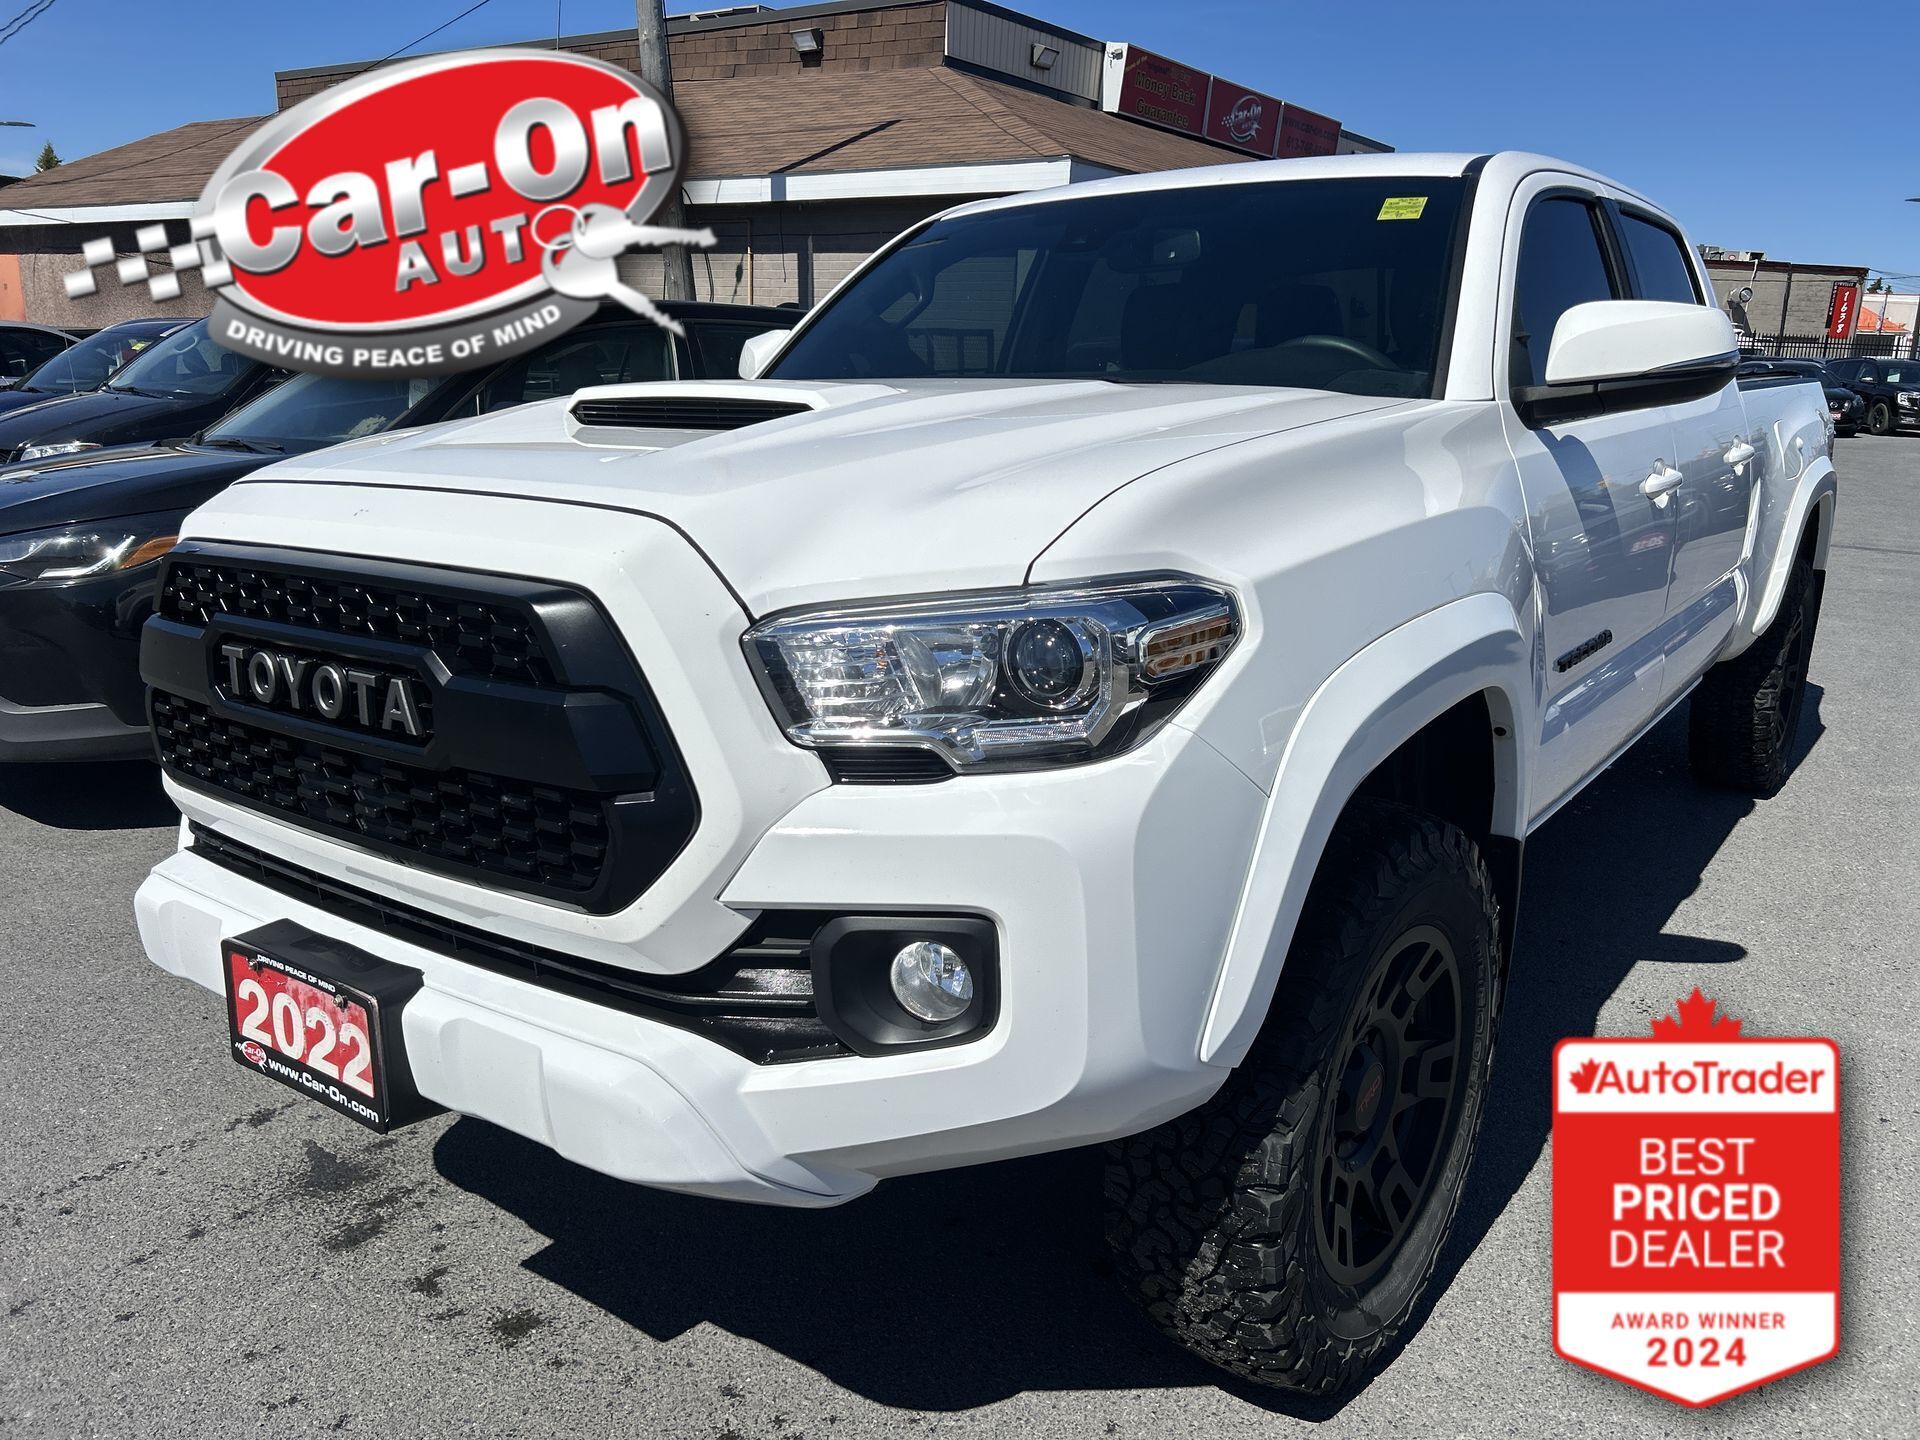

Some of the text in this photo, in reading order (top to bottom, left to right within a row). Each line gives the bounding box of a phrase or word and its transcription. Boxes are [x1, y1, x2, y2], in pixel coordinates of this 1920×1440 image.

[1135, 70, 1171, 100] Money
[1171, 82, 1196, 105] Back
[1136, 97, 1190, 128] Guarantee
[222, 644, 421, 736] TOYOTA
[257, 954, 336, 993] DRIVING PEACE OF MIND
[238, 978, 375, 1099] 2022
[268, 1058, 380, 1123] www.Car-On.com
